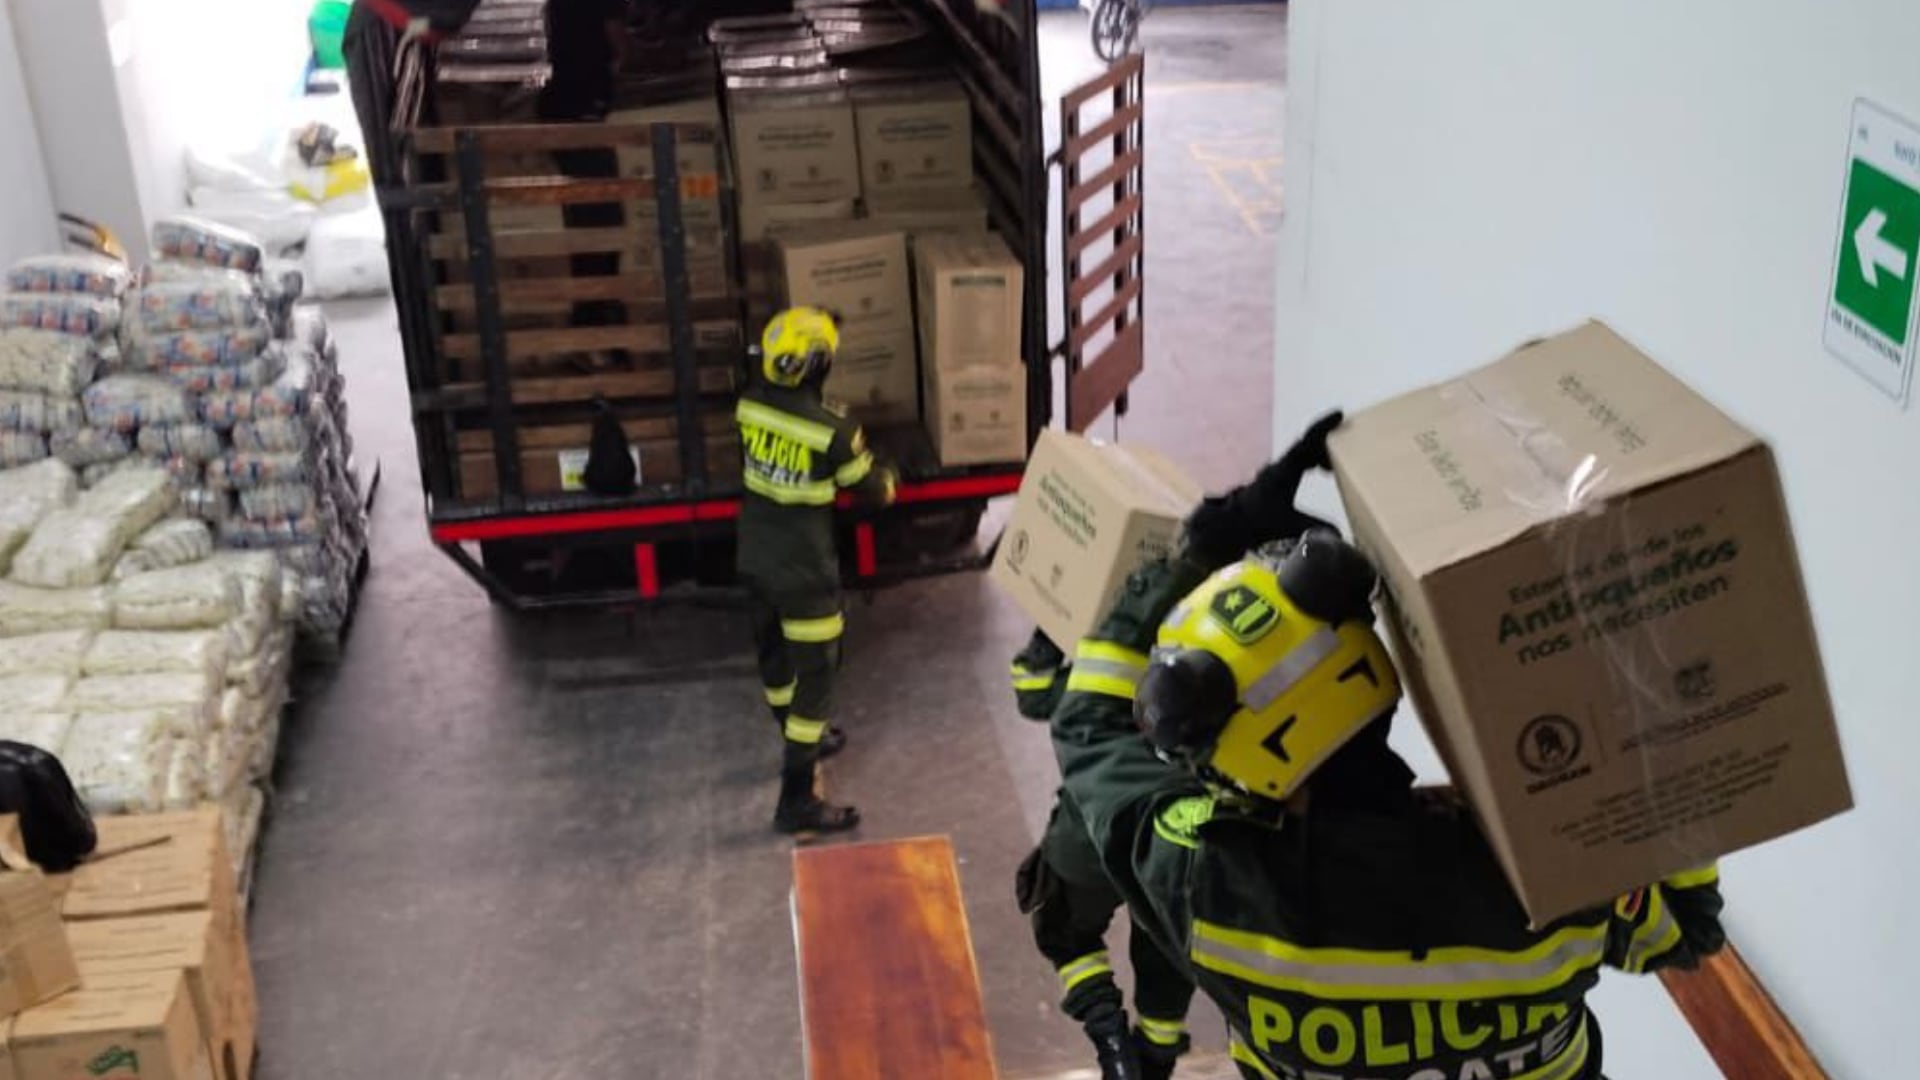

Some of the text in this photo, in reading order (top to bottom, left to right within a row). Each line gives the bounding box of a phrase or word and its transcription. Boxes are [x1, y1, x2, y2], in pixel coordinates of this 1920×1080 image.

[1517, 576, 1730, 665] nos necesiten
[1247, 995, 1573, 1067] POLICIA
